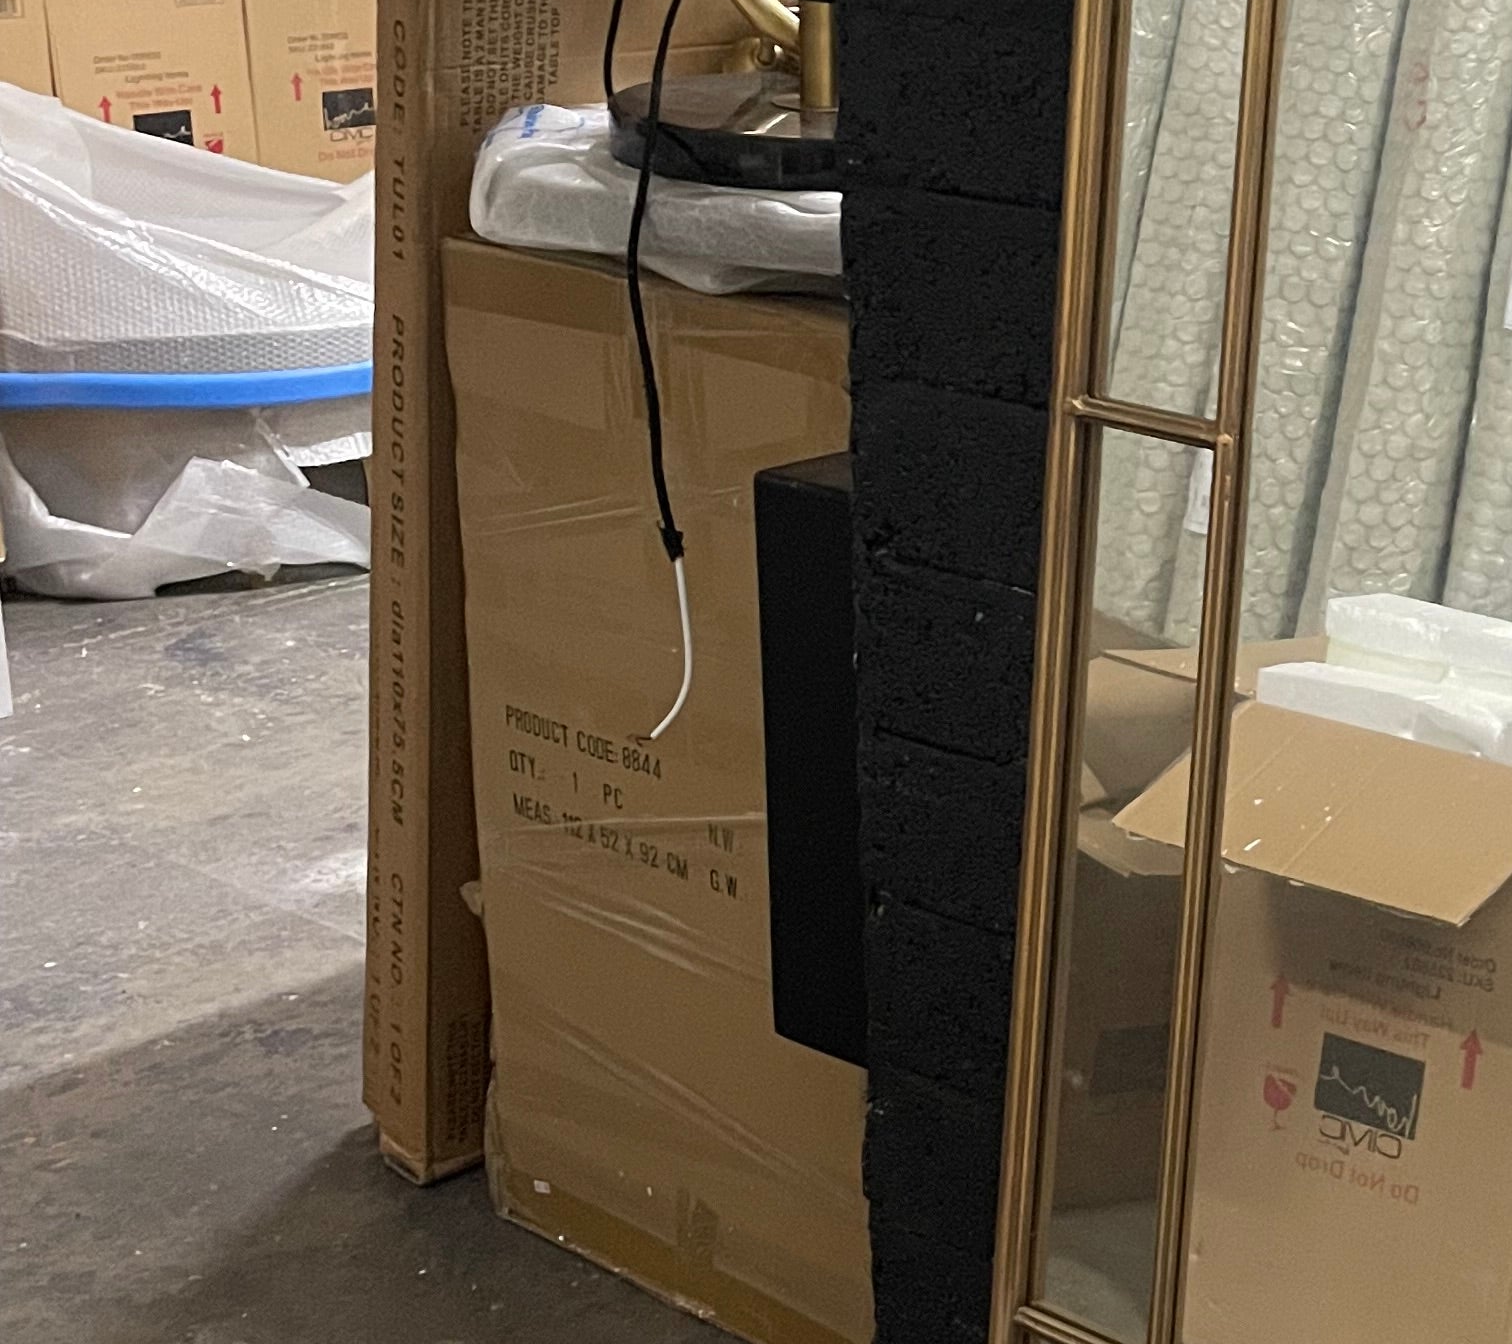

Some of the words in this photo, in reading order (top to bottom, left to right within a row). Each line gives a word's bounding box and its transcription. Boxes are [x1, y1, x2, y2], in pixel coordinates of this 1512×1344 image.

[461, 18, 473, 60] NOTE
[475, 7, 486, 40] MAN
[538, 20, 548, 38] TO
[550, 7, 560, 35] TOP
[487, 29, 498, 56] SET
[500, 35, 510, 59] ITS
[512, 11, 524, 70] WEIGHT
[474, 69, 484, 83] IS
[486, 60, 497, 90] NOT
[499, 60, 509, 83] ON
[523, 50, 534, 101] CAUSE
[536, 43, 547, 104] DAMAGE
[548, 40, 559, 86] TABLE
[459, 64, 472, 127] PLEASE
[486, 94, 497, 116] DO
[511, 73, 522, 101] THE
[472, 87, 485, 134] TABLE
[391, 314, 405, 484] PRODUCT
[506, 704, 568, 748] PRODUCT
[576, 729, 619, 764] CODE:
[622, 746, 662, 780] 8844
[602, 783, 624, 810] PC
[600, 827, 619, 853] 52
[639, 842, 659, 869] 92
[666, 851, 689, 881] CM
[390, 872, 404, 935] CTN
[390, 1042, 402, 1078] OF
